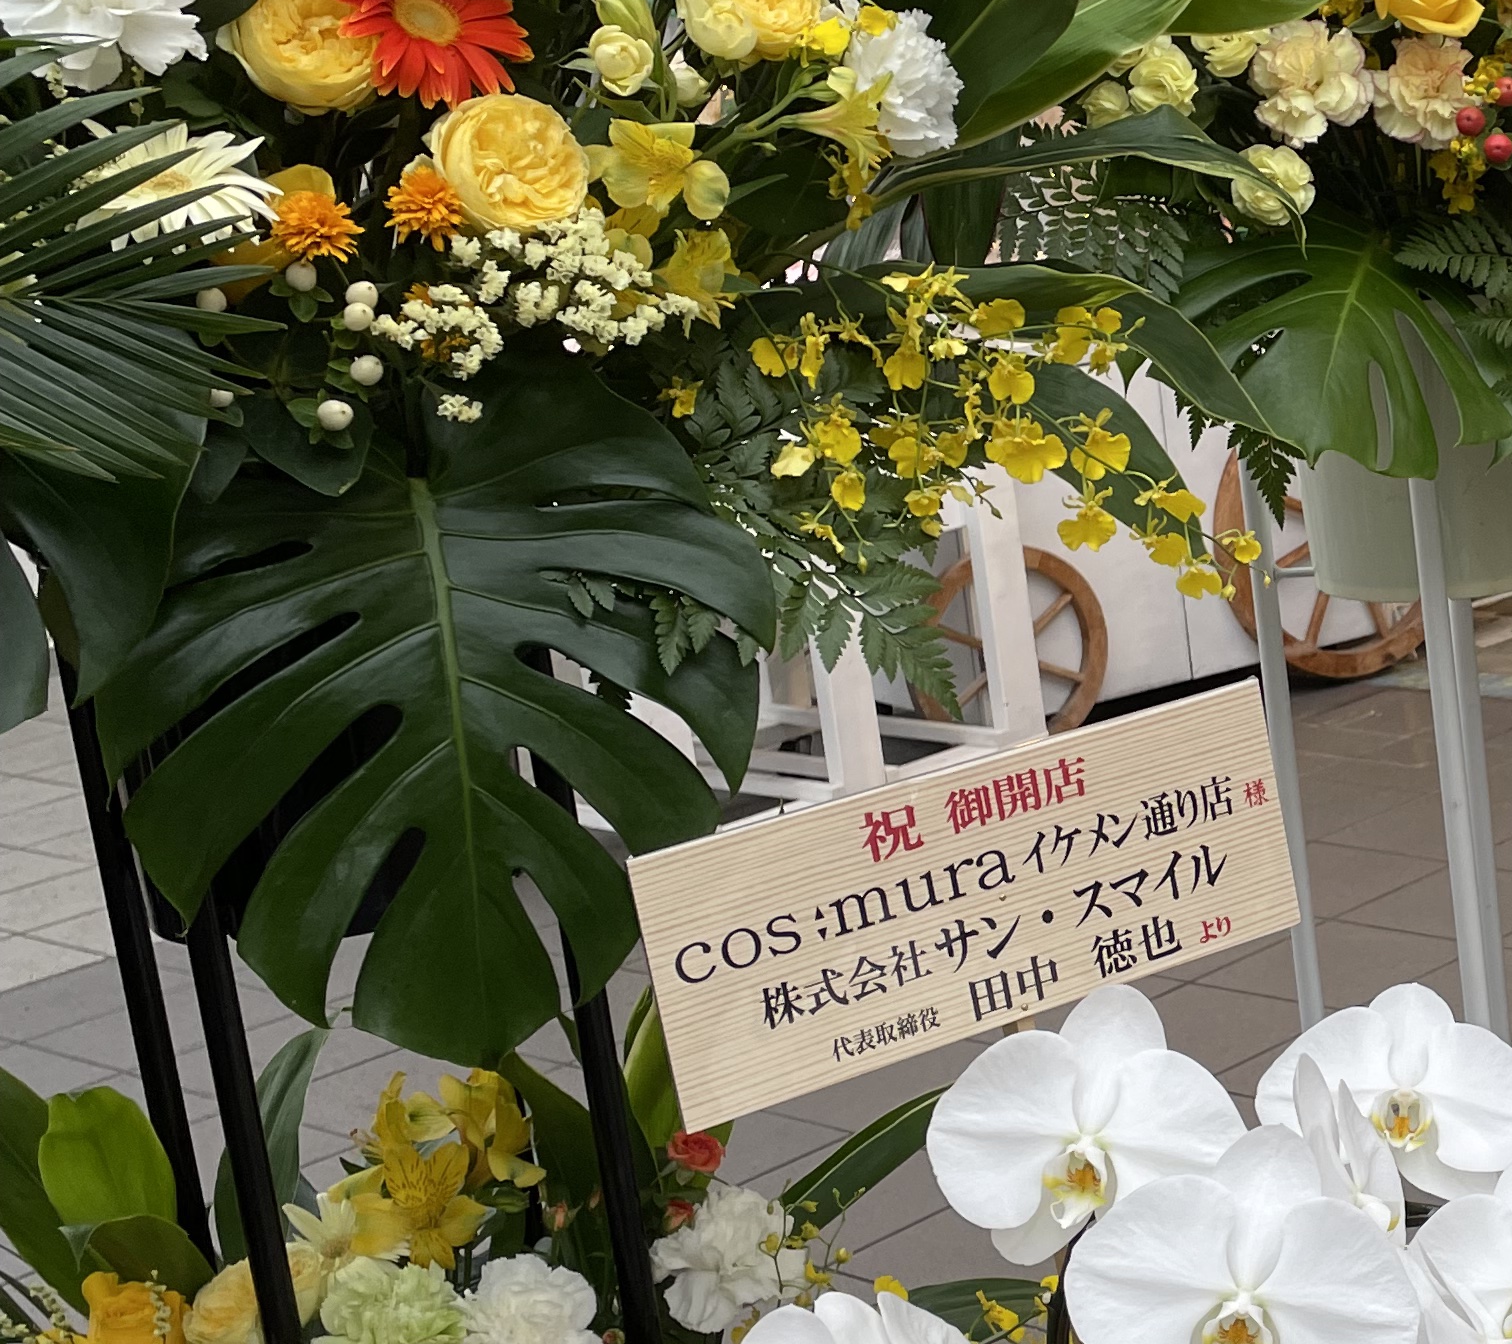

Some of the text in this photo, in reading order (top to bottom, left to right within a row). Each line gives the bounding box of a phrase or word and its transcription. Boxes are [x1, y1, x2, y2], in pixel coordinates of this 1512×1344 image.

[831, 1005, 941, 1063] 代表取締役
